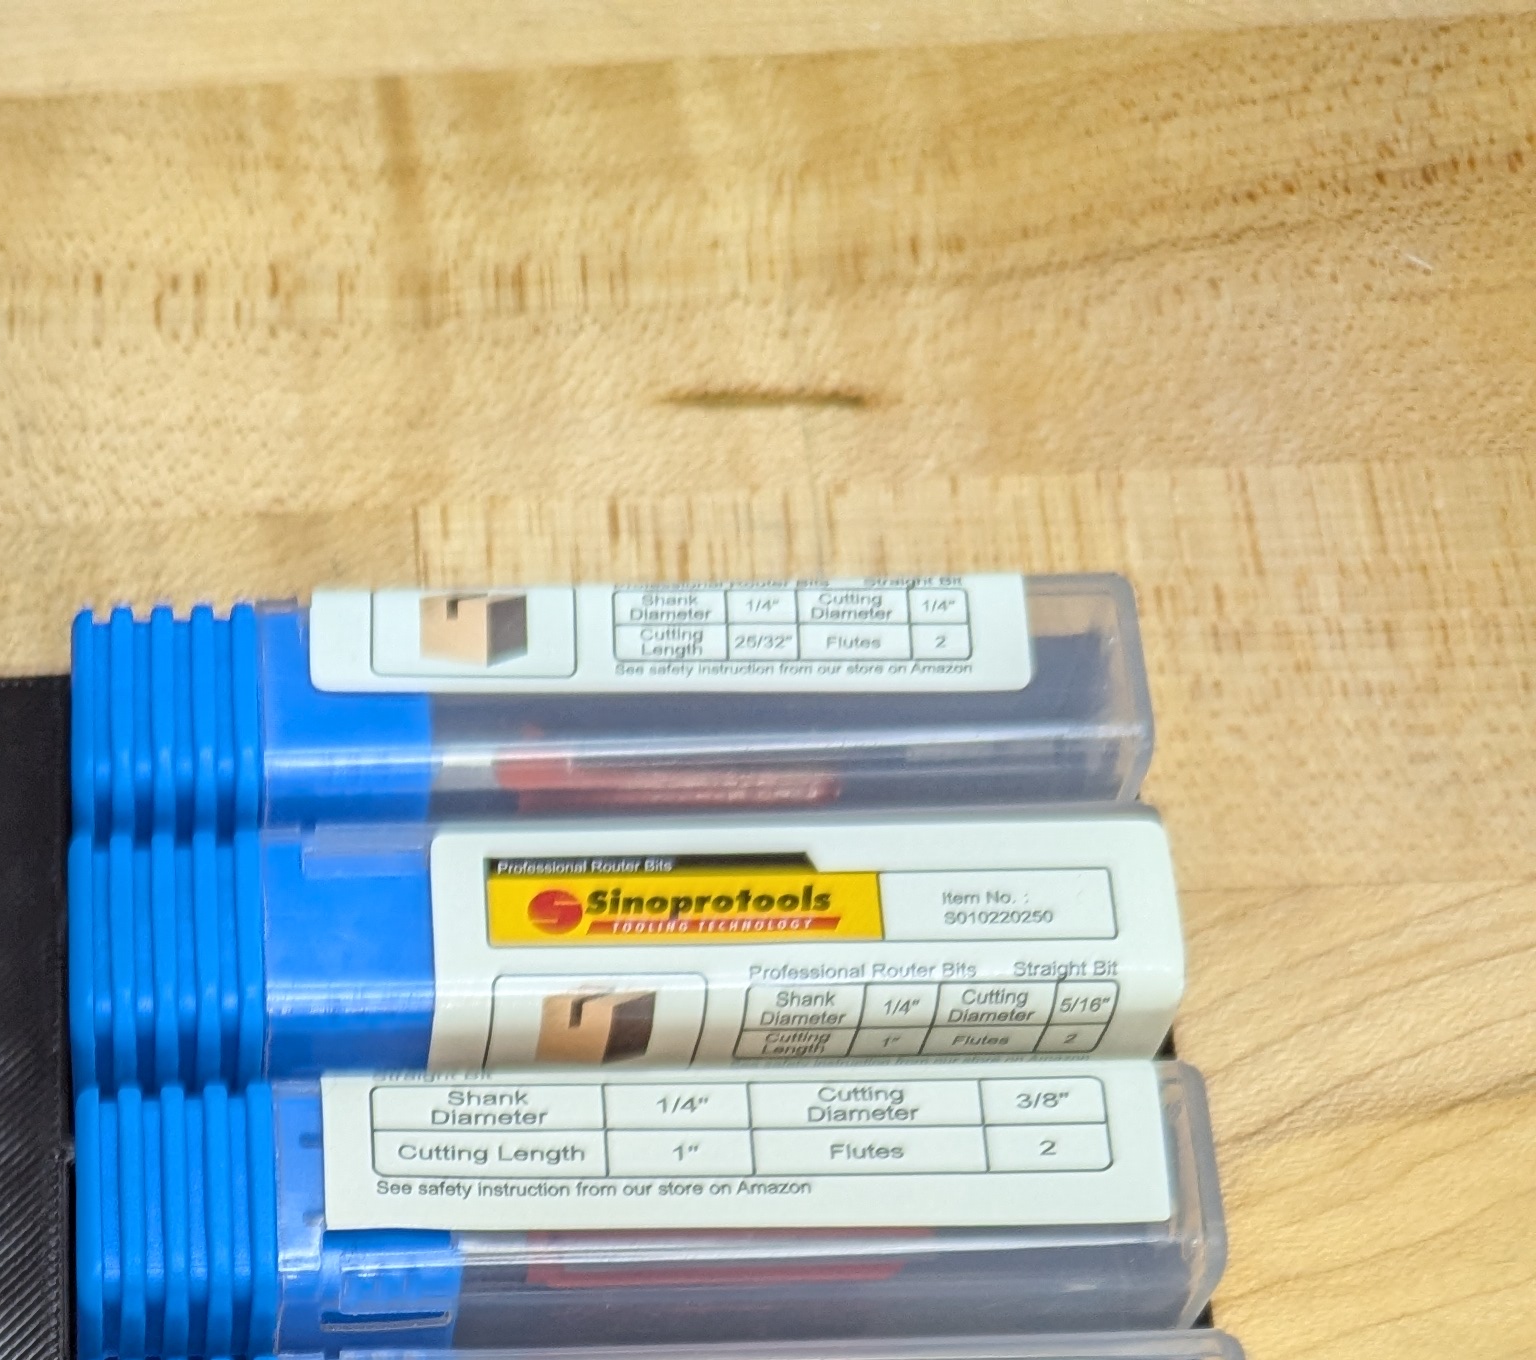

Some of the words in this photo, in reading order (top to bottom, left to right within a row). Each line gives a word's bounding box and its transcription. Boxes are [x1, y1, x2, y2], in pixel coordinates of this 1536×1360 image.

[642, 592, 698, 606] Shank
[818, 593, 883, 607] Cutting
[922, 599, 955, 612] 1/4"
[630, 608, 712, 621] Diameter
[811, 607, 892, 620] Diameter
[640, 628, 704, 643] Cutting
[826, 636, 882, 649] Flutes
[935, 636, 946, 649] 2
[641, 643, 704, 659] Length
[615, 664, 644, 676] See
[649, 664, 694, 678] safety
[698, 663, 774, 676] instruction
[779, 663, 812, 675] from
[817, 664, 841, 674] our
[846, 663, 883, 674] store
[888, 664, 907, 674] on
[910, 663, 973, 675] Amazon
[497, 859, 587, 875] Professional
[591, 859, 640, 873] Router
[644, 858, 673, 873] Bits
[585, 885, 832, 921] Sinoprotools
[942, 891, 980, 905] Item
[986, 890, 1016, 904] No.
[943, 909, 1054, 925] S010220250
[612, 919, 689, 935] TOOLING
[698, 917, 813, 933] TECHNOLOGY
[748, 964, 865, 981] Professional
[872, 962, 936, 979] Router
[941, 961, 977, 978] Bits
[1012, 959, 1089, 982] Straight
[1092, 959, 1118, 977] Bit
[775, 991, 837, 1008] Shank
[961, 989, 1029, 1007] Cutting
[1059, 997, 1111, 1014] 5/16"
[883, 998, 921, 1016] 1/4"
[759, 1011, 847, 1027] Diameter
[947, 1008, 1036, 1024] Diameter
[764, 1031, 831, 1046] Cutting
[882, 1035, 901, 1048] 1"
[952, 1034, 1010, 1047] Flutes
[1063, 1034, 1079, 1045] 2
[446, 1089, 529, 1107] Shank
[817, 1086, 905, 1105] Cutting
[1015, 1091, 1070, 1109] 3/8"
[656, 1095, 709, 1114] 1/4"
[430, 1109, 548, 1126] Diameter
[807, 1105, 920, 1123] Diameter
[397, 1144, 489, 1165] Cutting
[497, 1143, 586, 1165] Length
[671, 1145, 699, 1162] 1"
[829, 1143, 904, 1160] Flutes
[1039, 1140, 1057, 1156] 2
[376, 1181, 412, 1196] See
[418, 1180, 472, 1200] safety
[477, 1180, 571, 1197] instruction
[576, 1180, 617, 1197] from
[622, 1184, 652, 1197] our
[658, 1182, 704, 1196] store
[709, 1183, 732, 1195] on
[736, 1180, 813, 1196] Amazon
